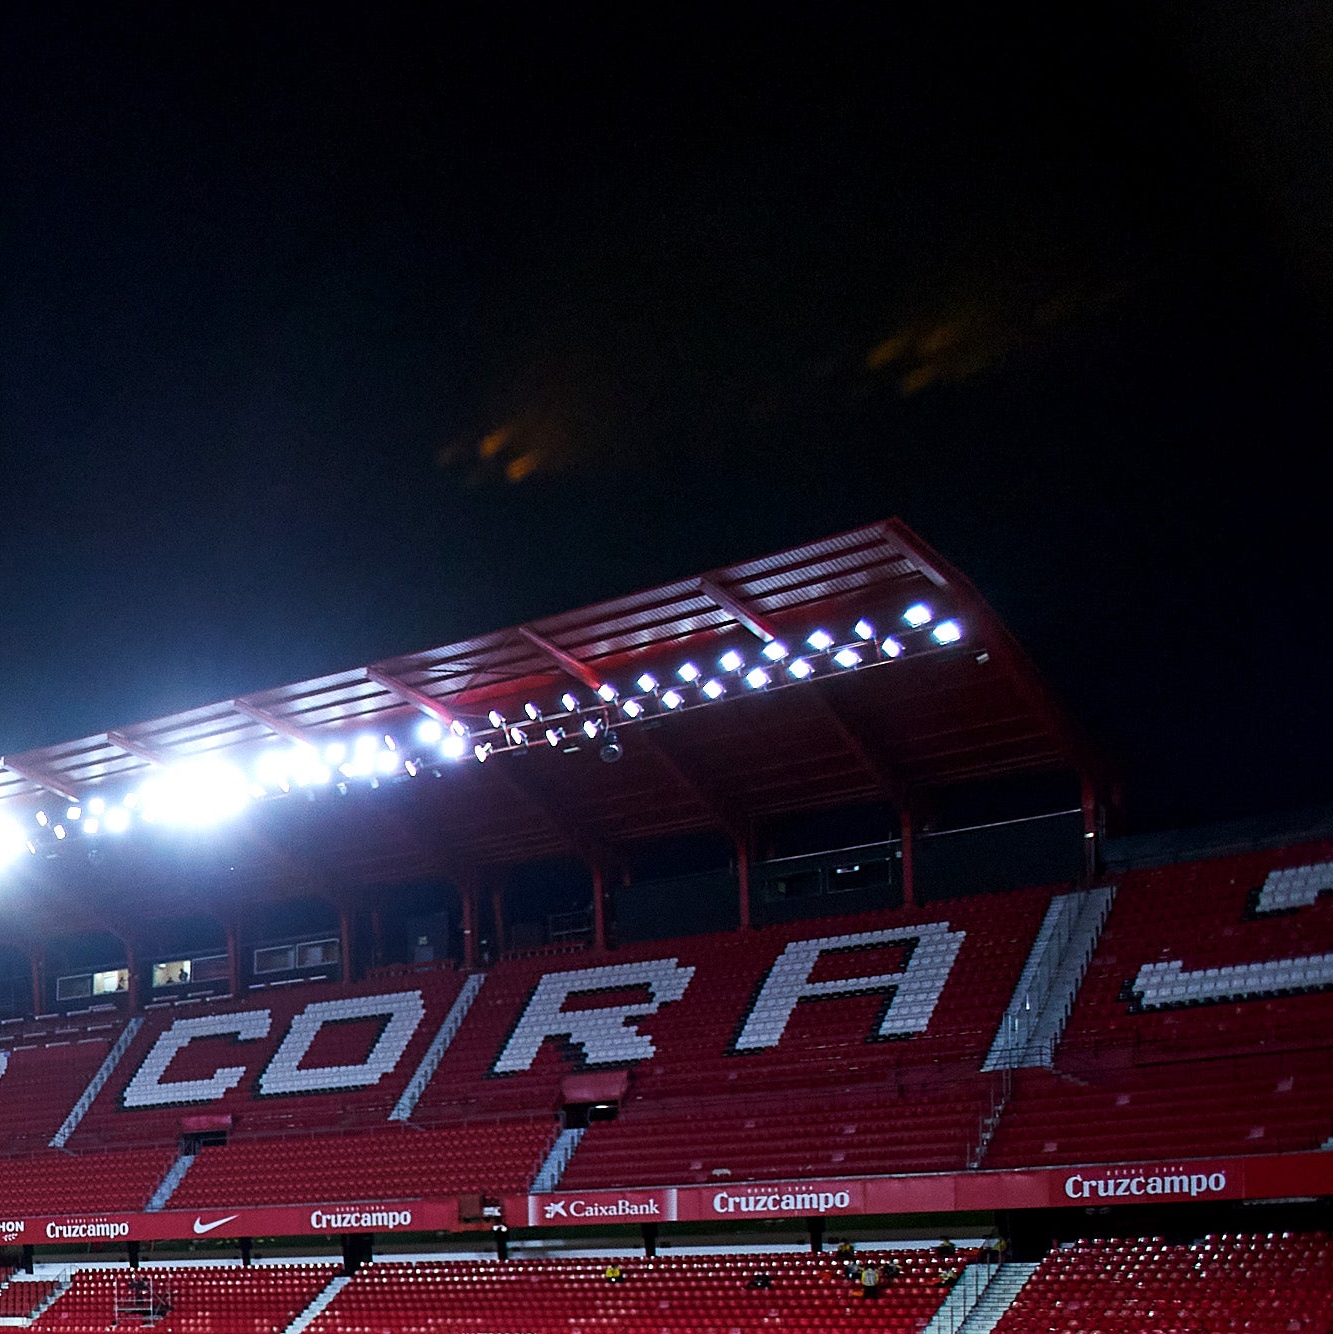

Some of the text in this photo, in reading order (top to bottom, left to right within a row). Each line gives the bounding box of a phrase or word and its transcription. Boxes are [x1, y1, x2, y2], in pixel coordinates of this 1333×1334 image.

[1064, 1172, 1226, 1198] Cruzcampo
[569, 1199, 660, 1218] CaixaBank
[713, 1191, 850, 1214] Cruzcampo
[310, 1209, 412, 1229] Cruzcampo
[46, 1221, 129, 1240] Cruzcampo
